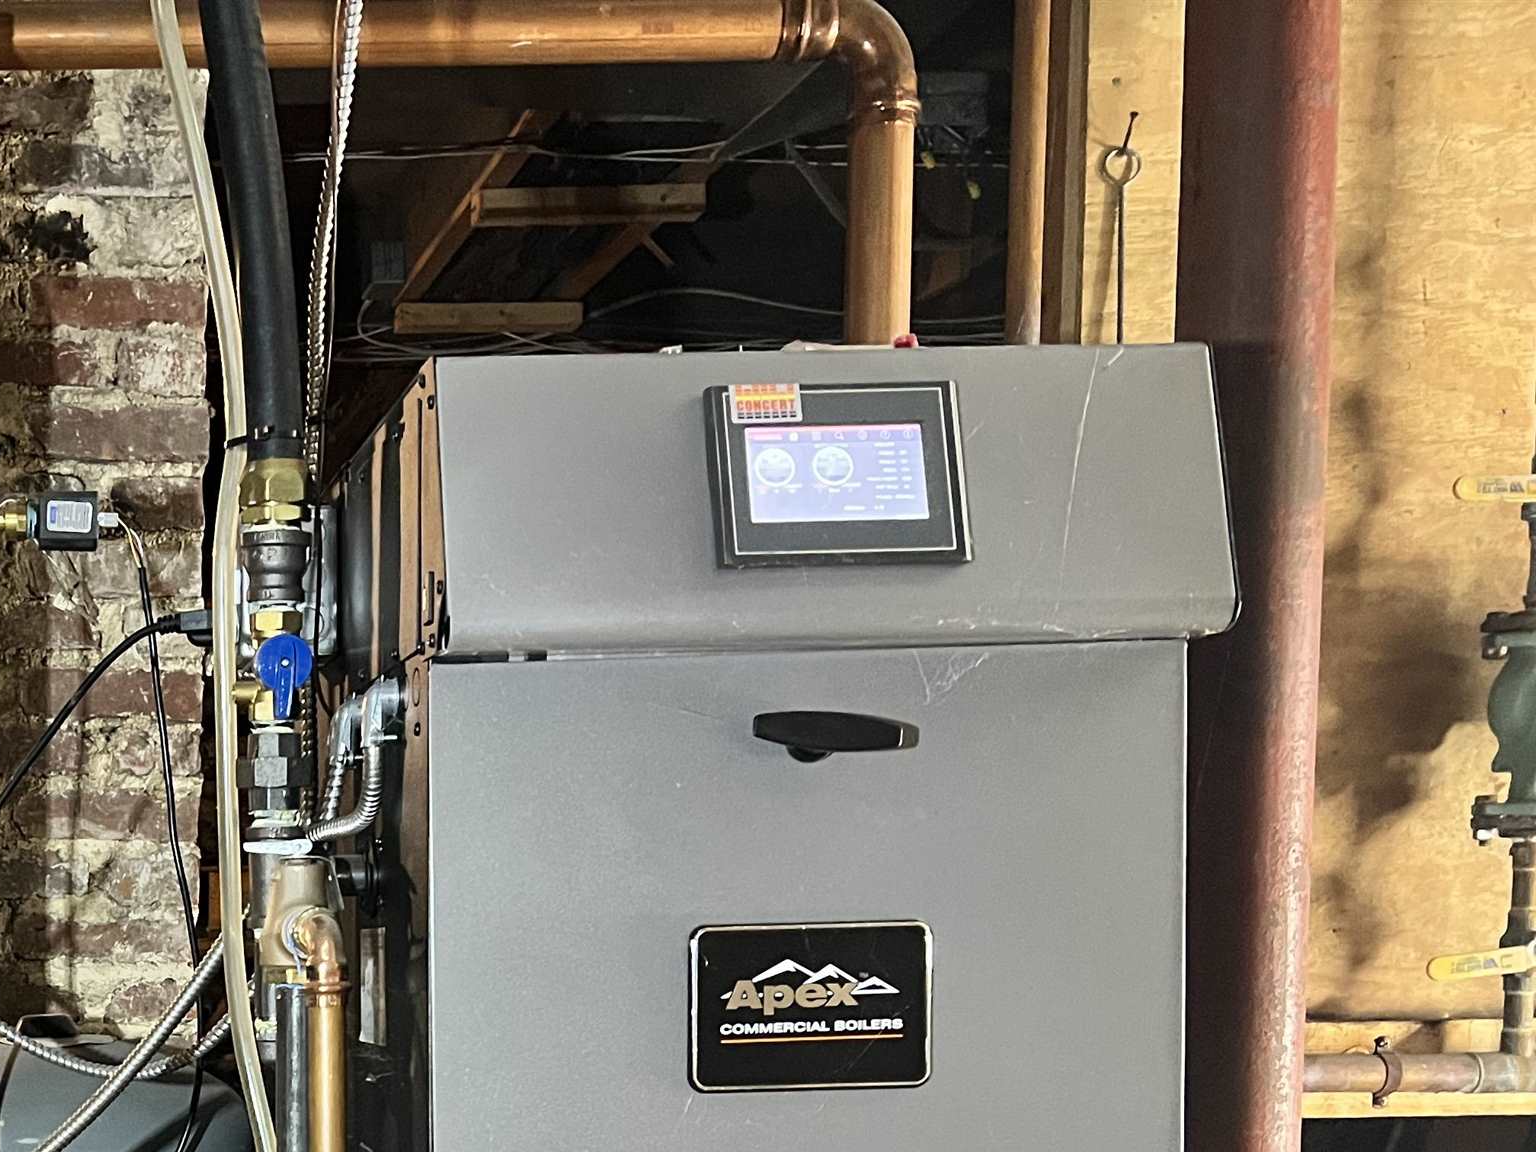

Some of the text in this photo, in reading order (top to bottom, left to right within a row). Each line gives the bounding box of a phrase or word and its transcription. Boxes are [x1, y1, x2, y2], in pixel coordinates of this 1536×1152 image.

[726, 980, 859, 1016] Apex
[720, 1018, 904, 1036] COMMERCIAL BOILERS
